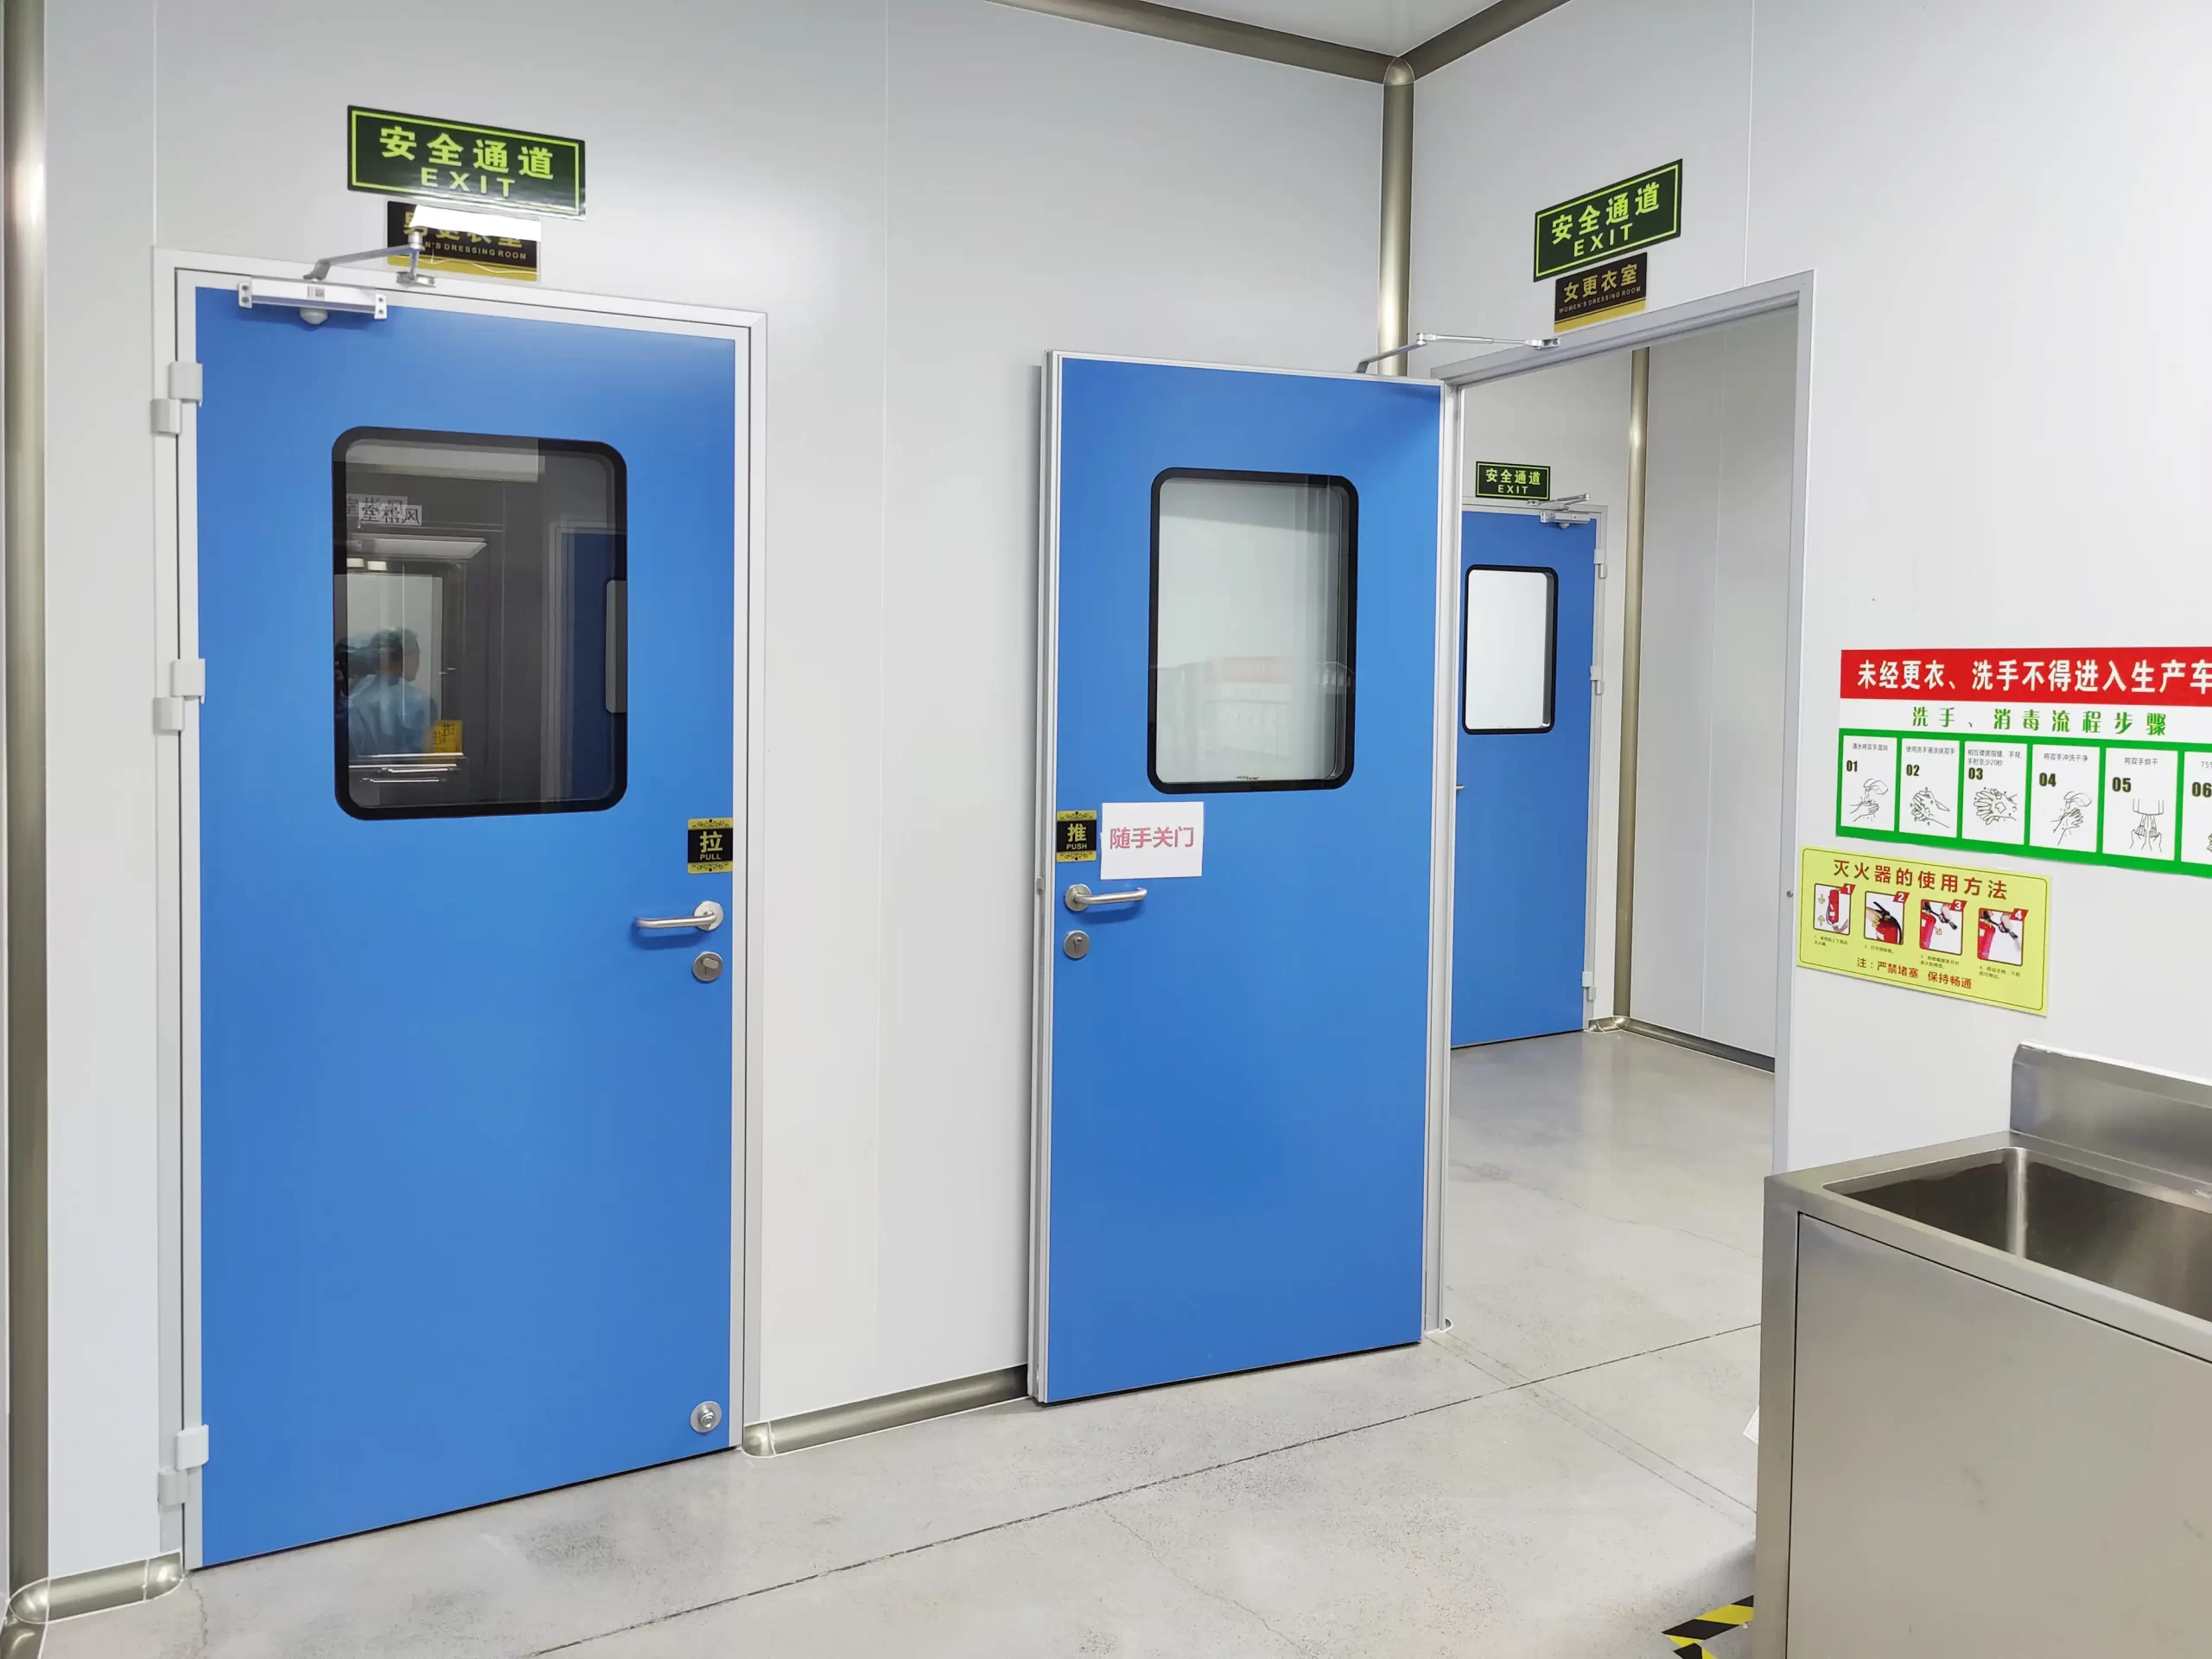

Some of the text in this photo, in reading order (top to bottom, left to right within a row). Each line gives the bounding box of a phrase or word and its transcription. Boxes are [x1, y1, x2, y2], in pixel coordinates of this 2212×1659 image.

[379, 126, 554, 180] 安全通道
[421, 167, 515, 197] EXIT
[1551, 181, 1660, 245] 安全通道
[1573, 223, 1633, 257] EXIT
[444, 244, 496, 257] DRESSING
[498, 250, 527, 260] ROOM
[1563, 264, 1638, 303] 女更衣室
[1558, 286, 1642, 315] WOMEN'S DRESSING ROOM
[1485, 467, 1541, 486] 安全通道
[1497, 485, 1529, 494] EXIT
[1856, 658, 2212, 696] 未经更衣、洗手不得进入生产车
[1912, 705, 2167, 736] 洗手、消毒流程步骤
[1846, 760, 1859, 772] 01
[1905, 764, 1921, 777] 02
[1967, 767, 1983, 781] 03
[2038, 772, 2056, 787] 04
[2112, 777, 2132, 792] 05
[2191, 781, 2212, 798] 06
[699, 830, 723, 853] 拉
[1067, 823, 1086, 842] 推
[1109, 826, 1194, 849] 随手关门
[1833, 858, 2007, 900] 灭火器的使用方法
[1846, 885, 1851, 895] 1
[1897, 892, 1905, 902] 2
[1955, 900, 1962, 911] 3
[2013, 909, 2023, 920] 4
[1928, 971, 1973, 990] 保持畅通
